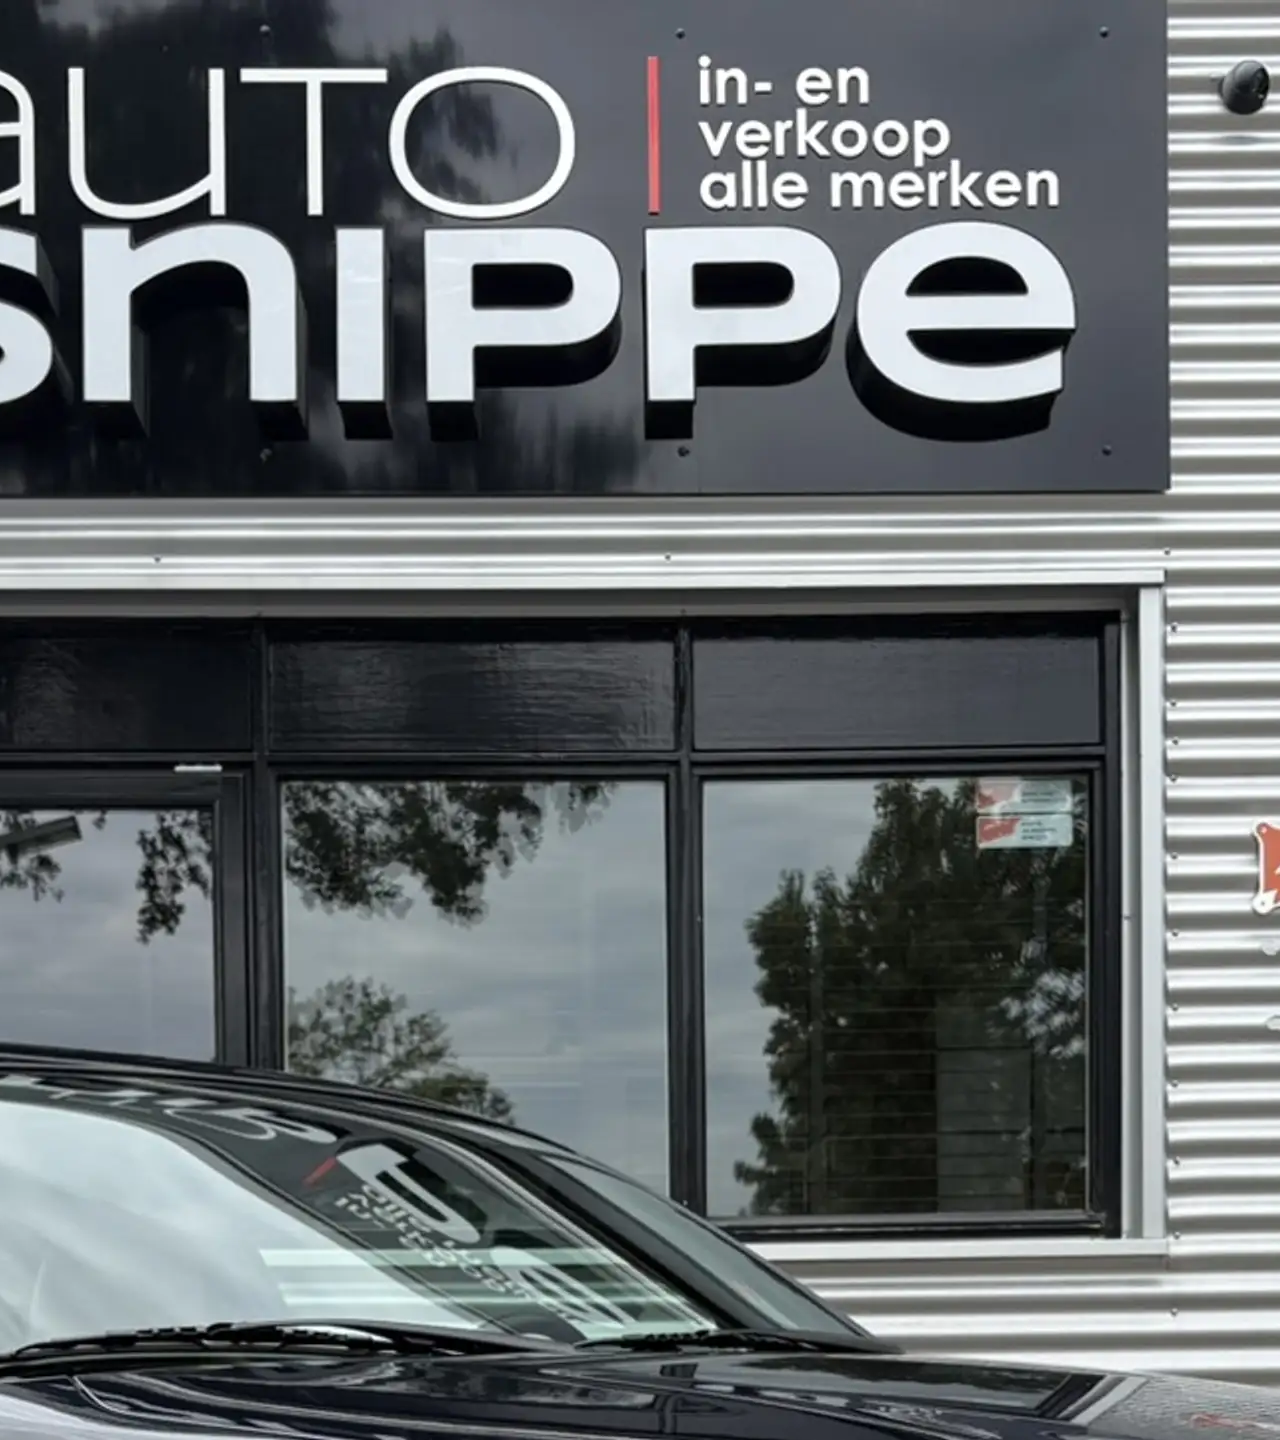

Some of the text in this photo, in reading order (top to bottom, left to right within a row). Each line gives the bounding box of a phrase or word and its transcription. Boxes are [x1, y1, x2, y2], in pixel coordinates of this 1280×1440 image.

[698, 55, 869, 105] in- en
[698, 108, 950, 167] verkoop
[699, 159, 1059, 209] alle merken
